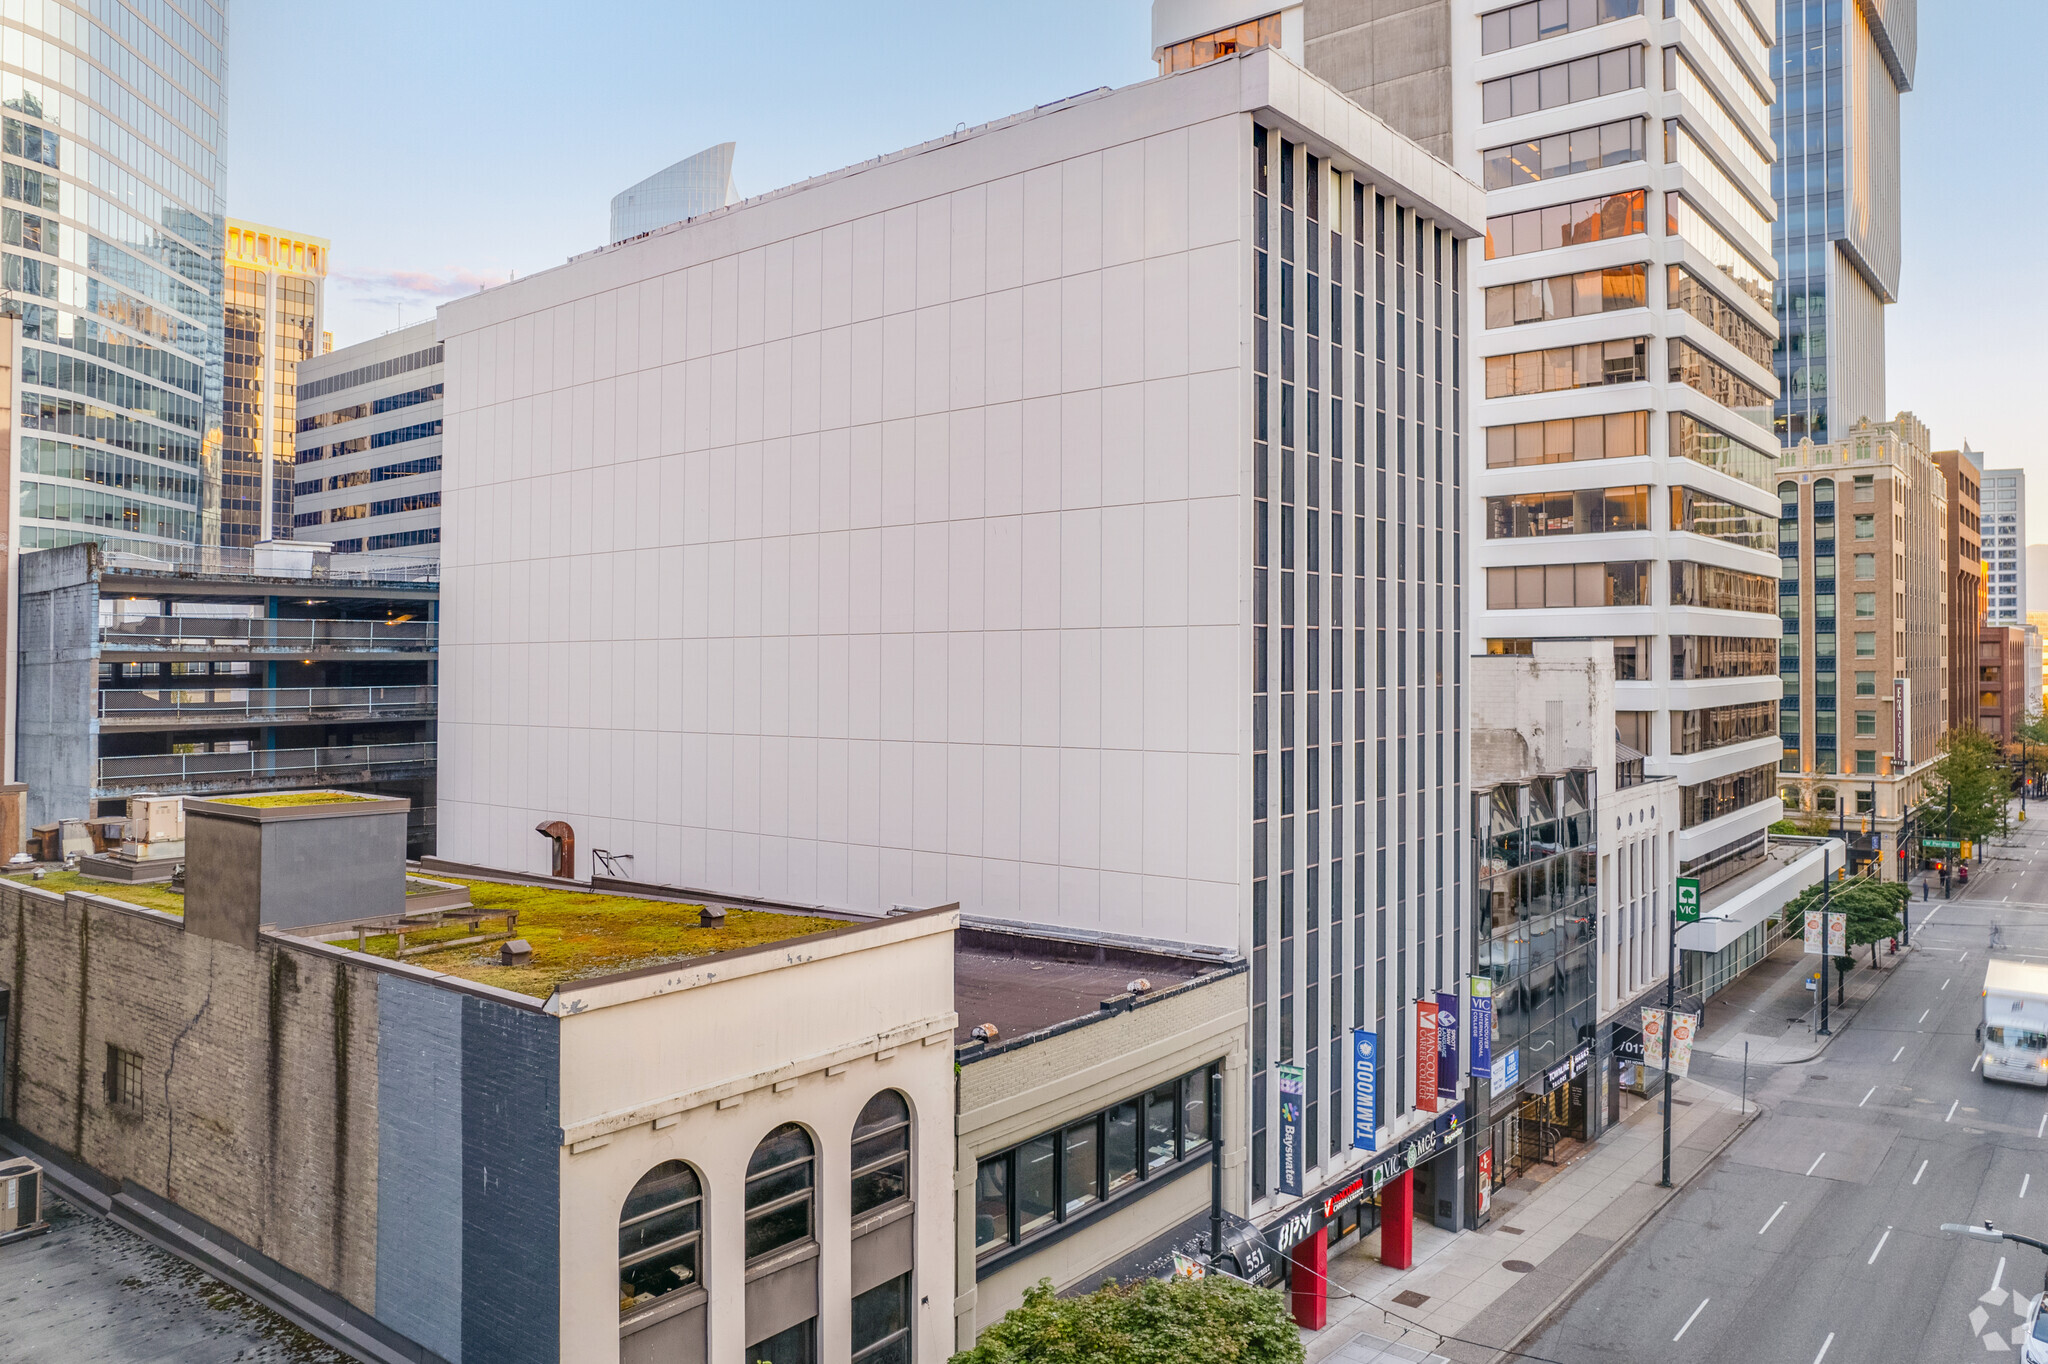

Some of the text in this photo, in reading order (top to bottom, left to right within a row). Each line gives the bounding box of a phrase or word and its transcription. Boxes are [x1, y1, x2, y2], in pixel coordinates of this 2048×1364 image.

[1679, 905, 1697, 915] VIC
[1472, 997, 1491, 1011] VIC
[1419, 1029, 1427, 1099] CAREER COLLEGE
[1426, 1031, 1436, 1100] VANCOUVER
[1356, 1061, 1374, 1139] TAMWOOD
[1283, 1124, 1296, 1188] Bayswater
[1417, 1130, 1437, 1156] MCC
[1383, 1154, 1401, 1179] VIC
[1332, 1178, 1364, 1204] VANCOUVER
[1245, 1247, 1265, 1273] 551
